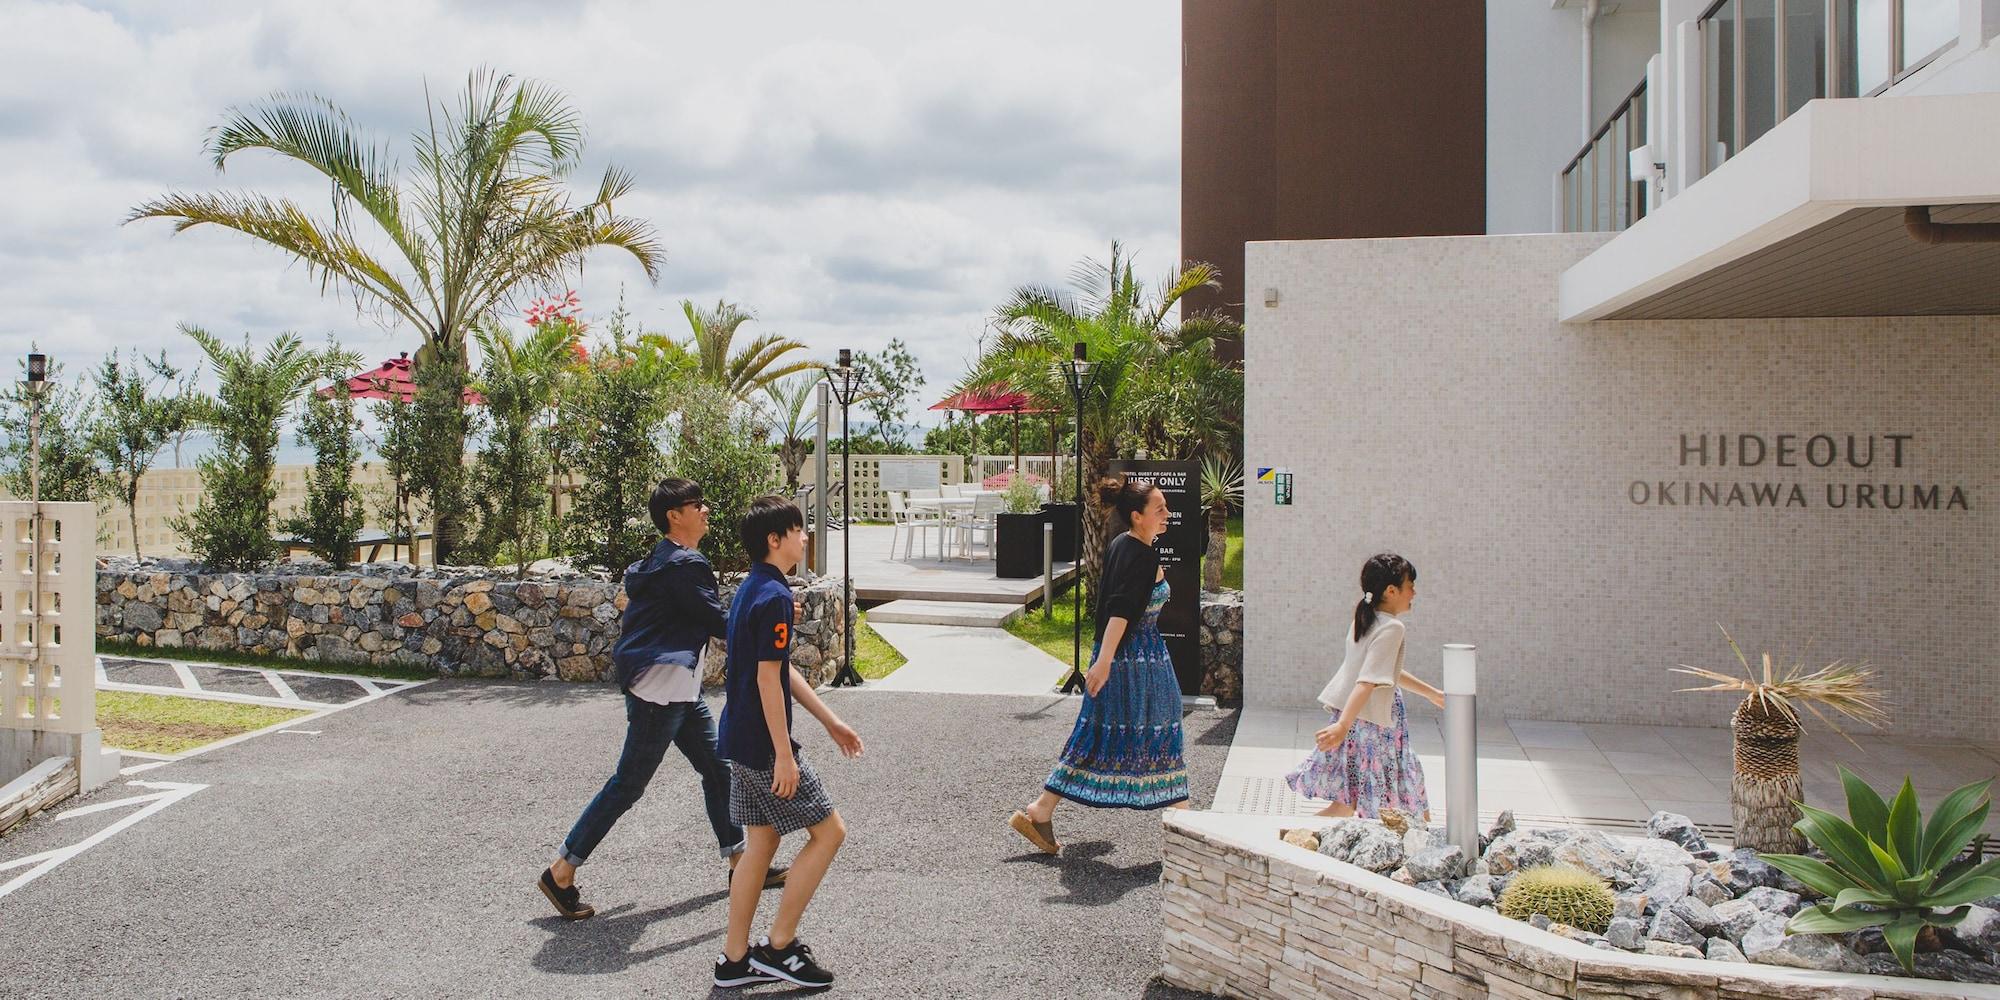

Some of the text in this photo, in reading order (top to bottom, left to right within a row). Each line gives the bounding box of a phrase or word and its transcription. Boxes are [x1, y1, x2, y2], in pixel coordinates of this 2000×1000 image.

[1679, 434, 1913, 468] HIDEOUT
[1127, 476, 1187, 486] UEST ONLY
[1628, 481, 1969, 510] OKINAWA URUMA
[774, 623, 788, 649] 3
[782, 955, 806, 972] N
